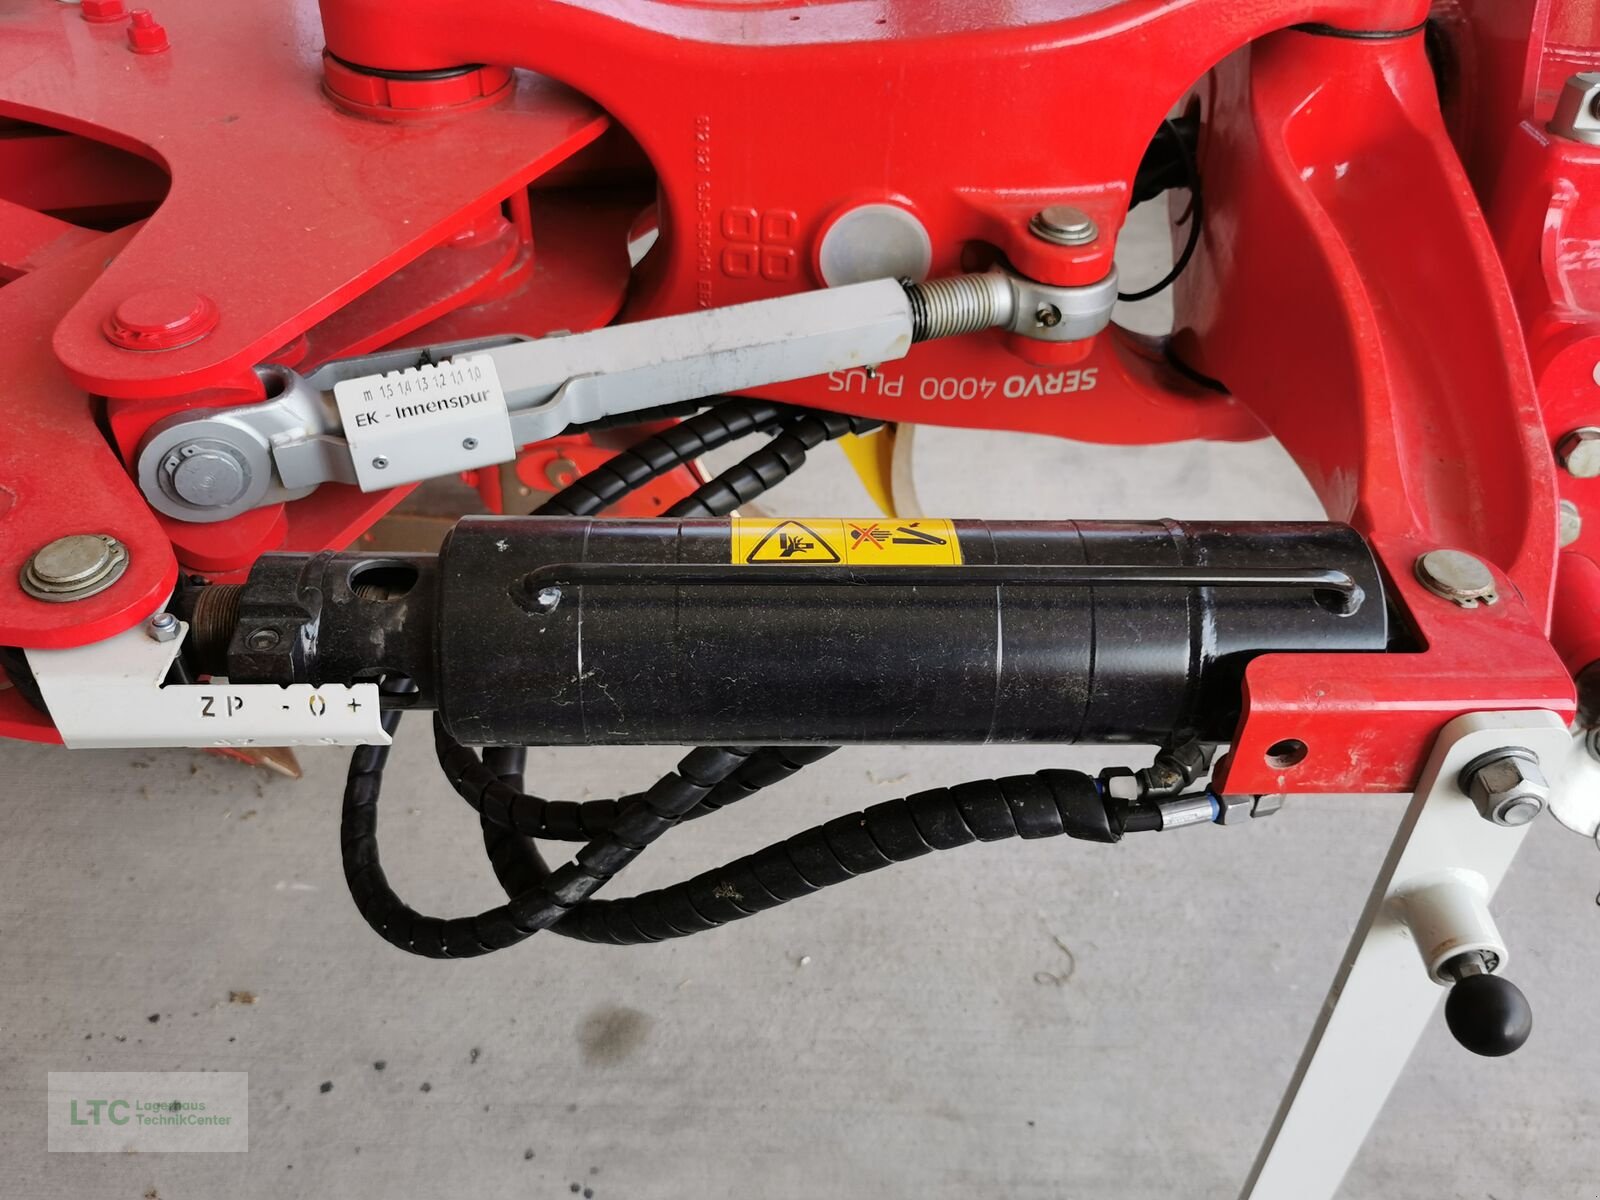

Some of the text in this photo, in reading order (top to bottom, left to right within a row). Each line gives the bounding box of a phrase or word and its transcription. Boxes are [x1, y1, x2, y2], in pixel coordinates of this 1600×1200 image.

[363, 366, 482, 402] m 1,5 1,4 1,3 1,2 1,1 1,0
[828, 367, 1098, 400] SERVO 4000 PLUS
[354, 410, 380, 428] EK
[395, 388, 492, 419] Innenspur
